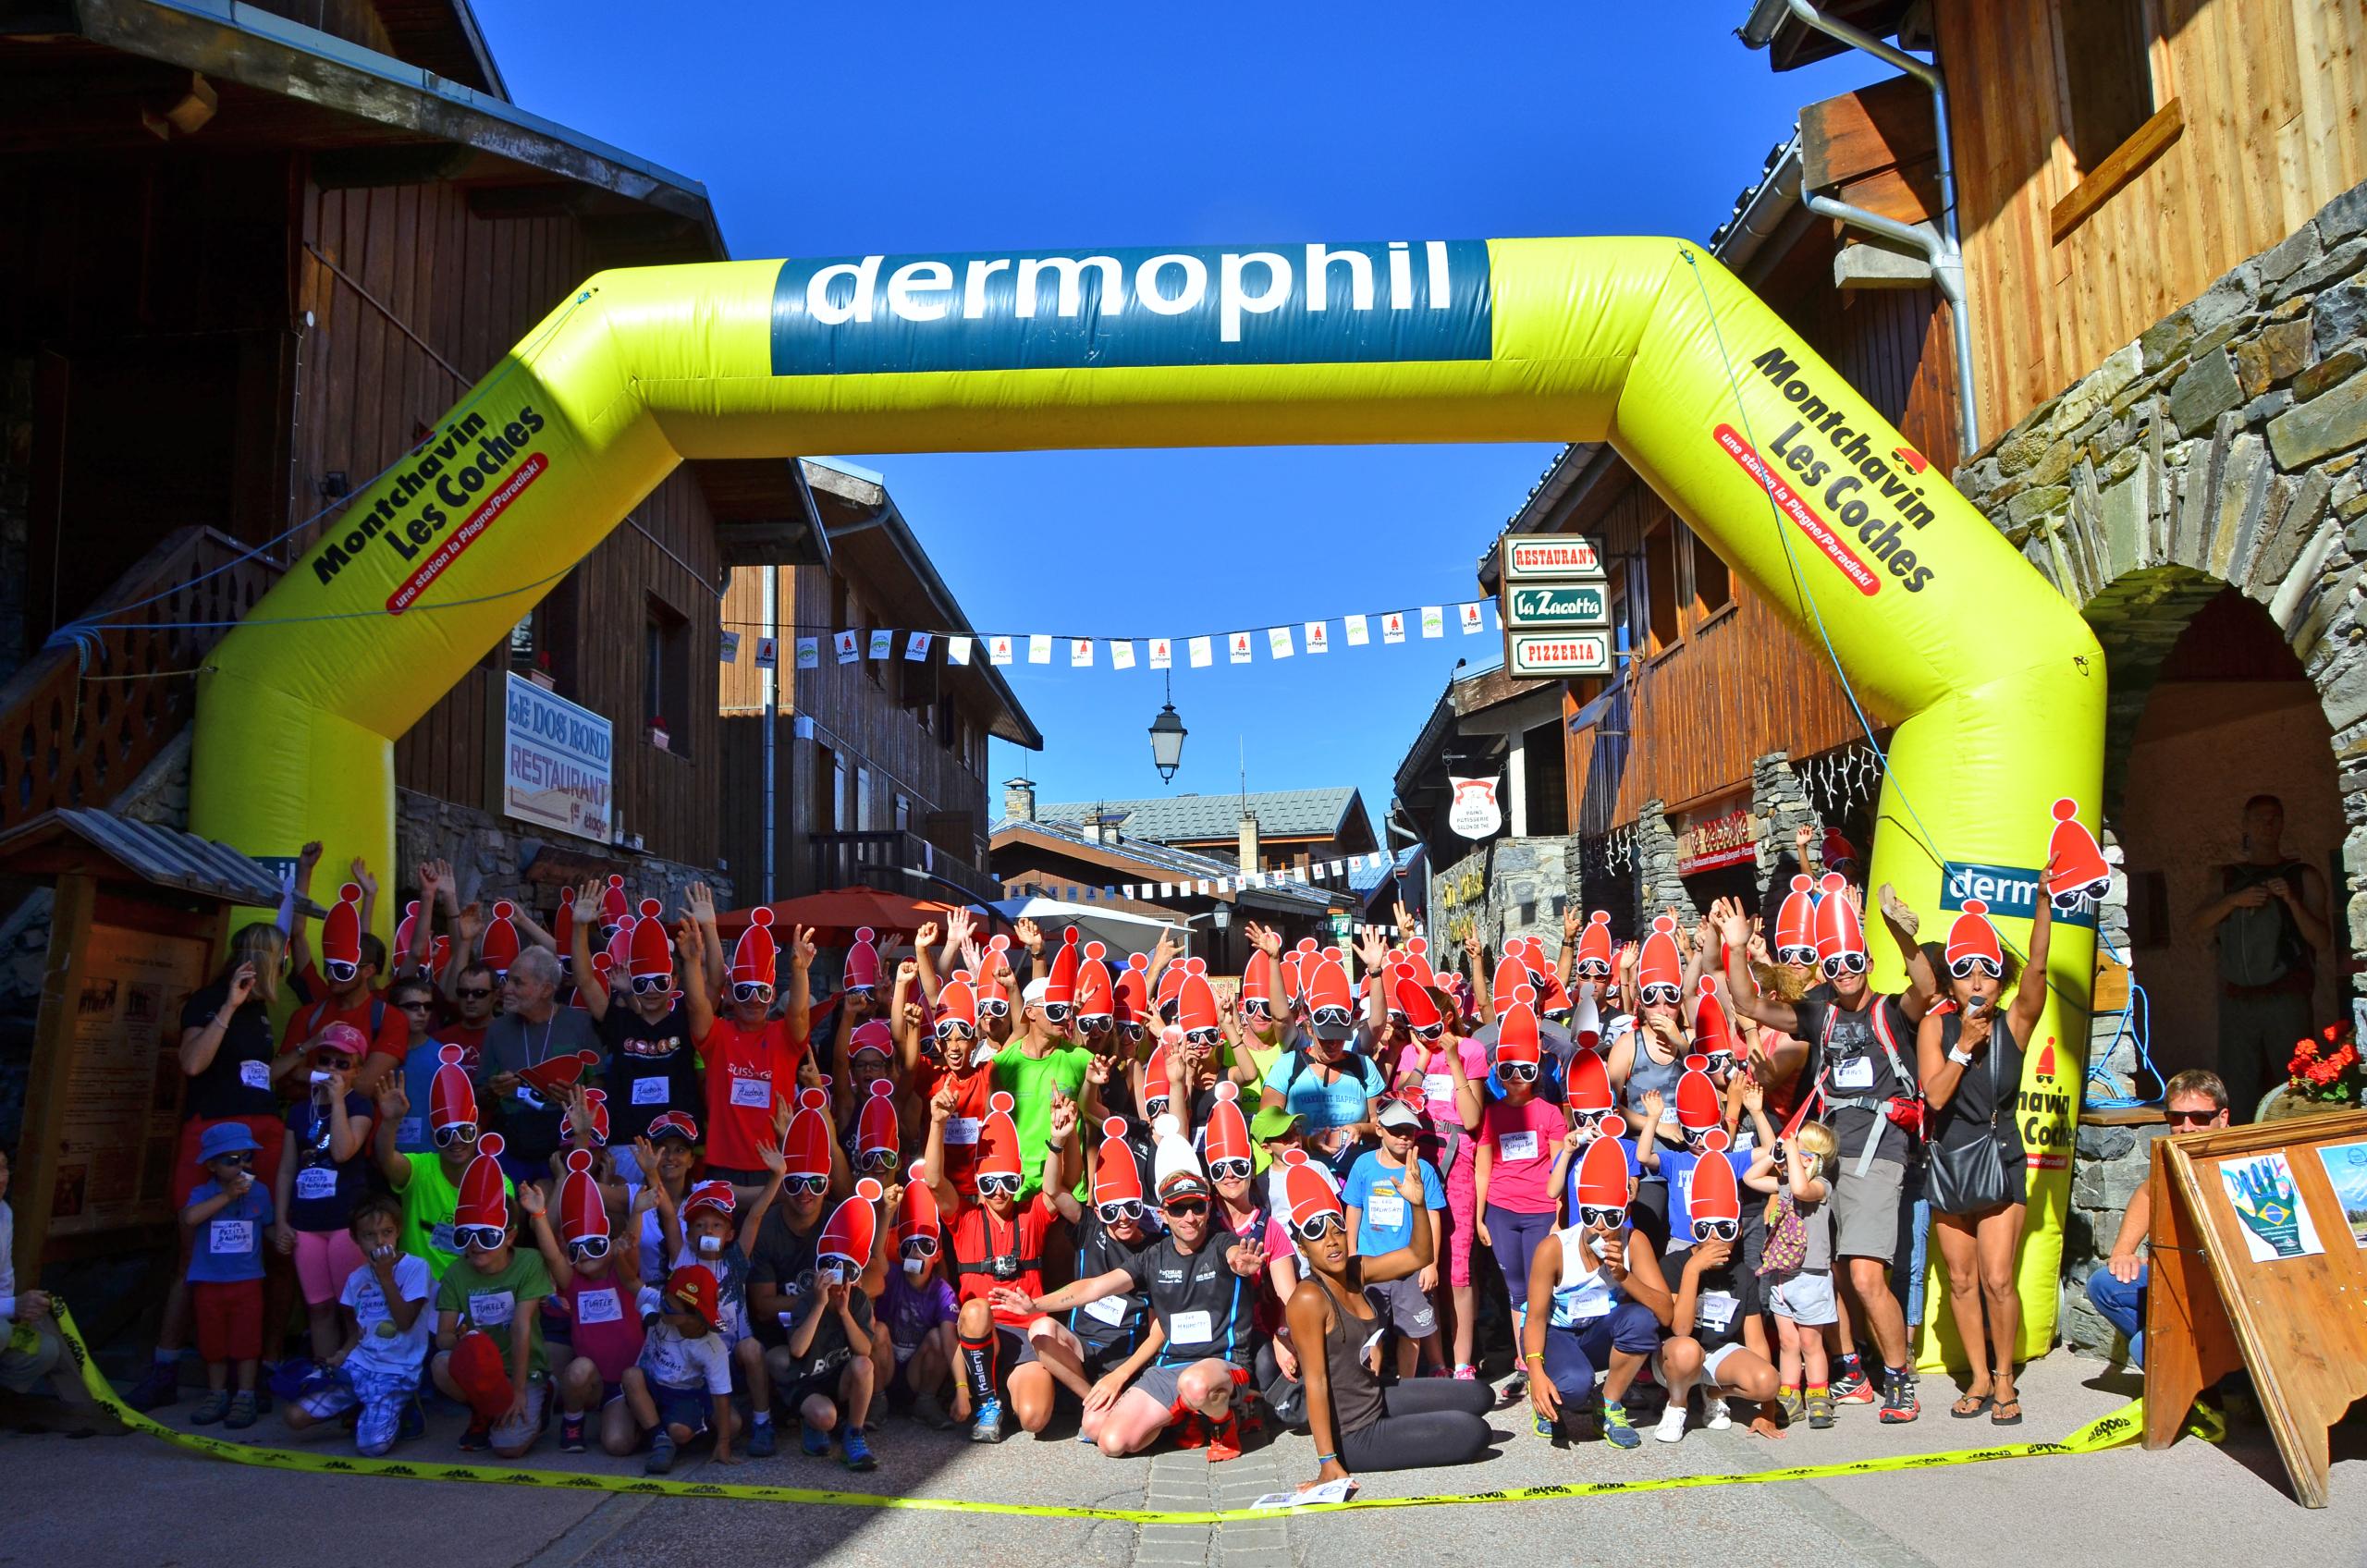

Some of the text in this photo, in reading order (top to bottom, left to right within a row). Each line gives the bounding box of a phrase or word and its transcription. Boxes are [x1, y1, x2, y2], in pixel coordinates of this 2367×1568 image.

[806, 240, 1451, 342] dermophil
[384, 406, 545, 562] Les Coches
[1751, 347, 1935, 531] Montchavin
[312, 411, 487, 585] Montchavin
[395, 459, 541, 608] une station la Plagne/Paradiski
[1721, 433, 1873, 587] une station la Plagne/Paradiski
[1769, 420, 1935, 593] Les Coches
[1515, 547, 1596, 566] RESTAURANT
[1536, 591, 1600, 616] Zacotta
[1528, 644, 1594, 662] PIZZERIA
[510, 743, 608, 807] RESTAURANT
[533, 701, 568, 741] DOS
[569, 717, 609, 764] ROND
[583, 808, 607, 839] étage
